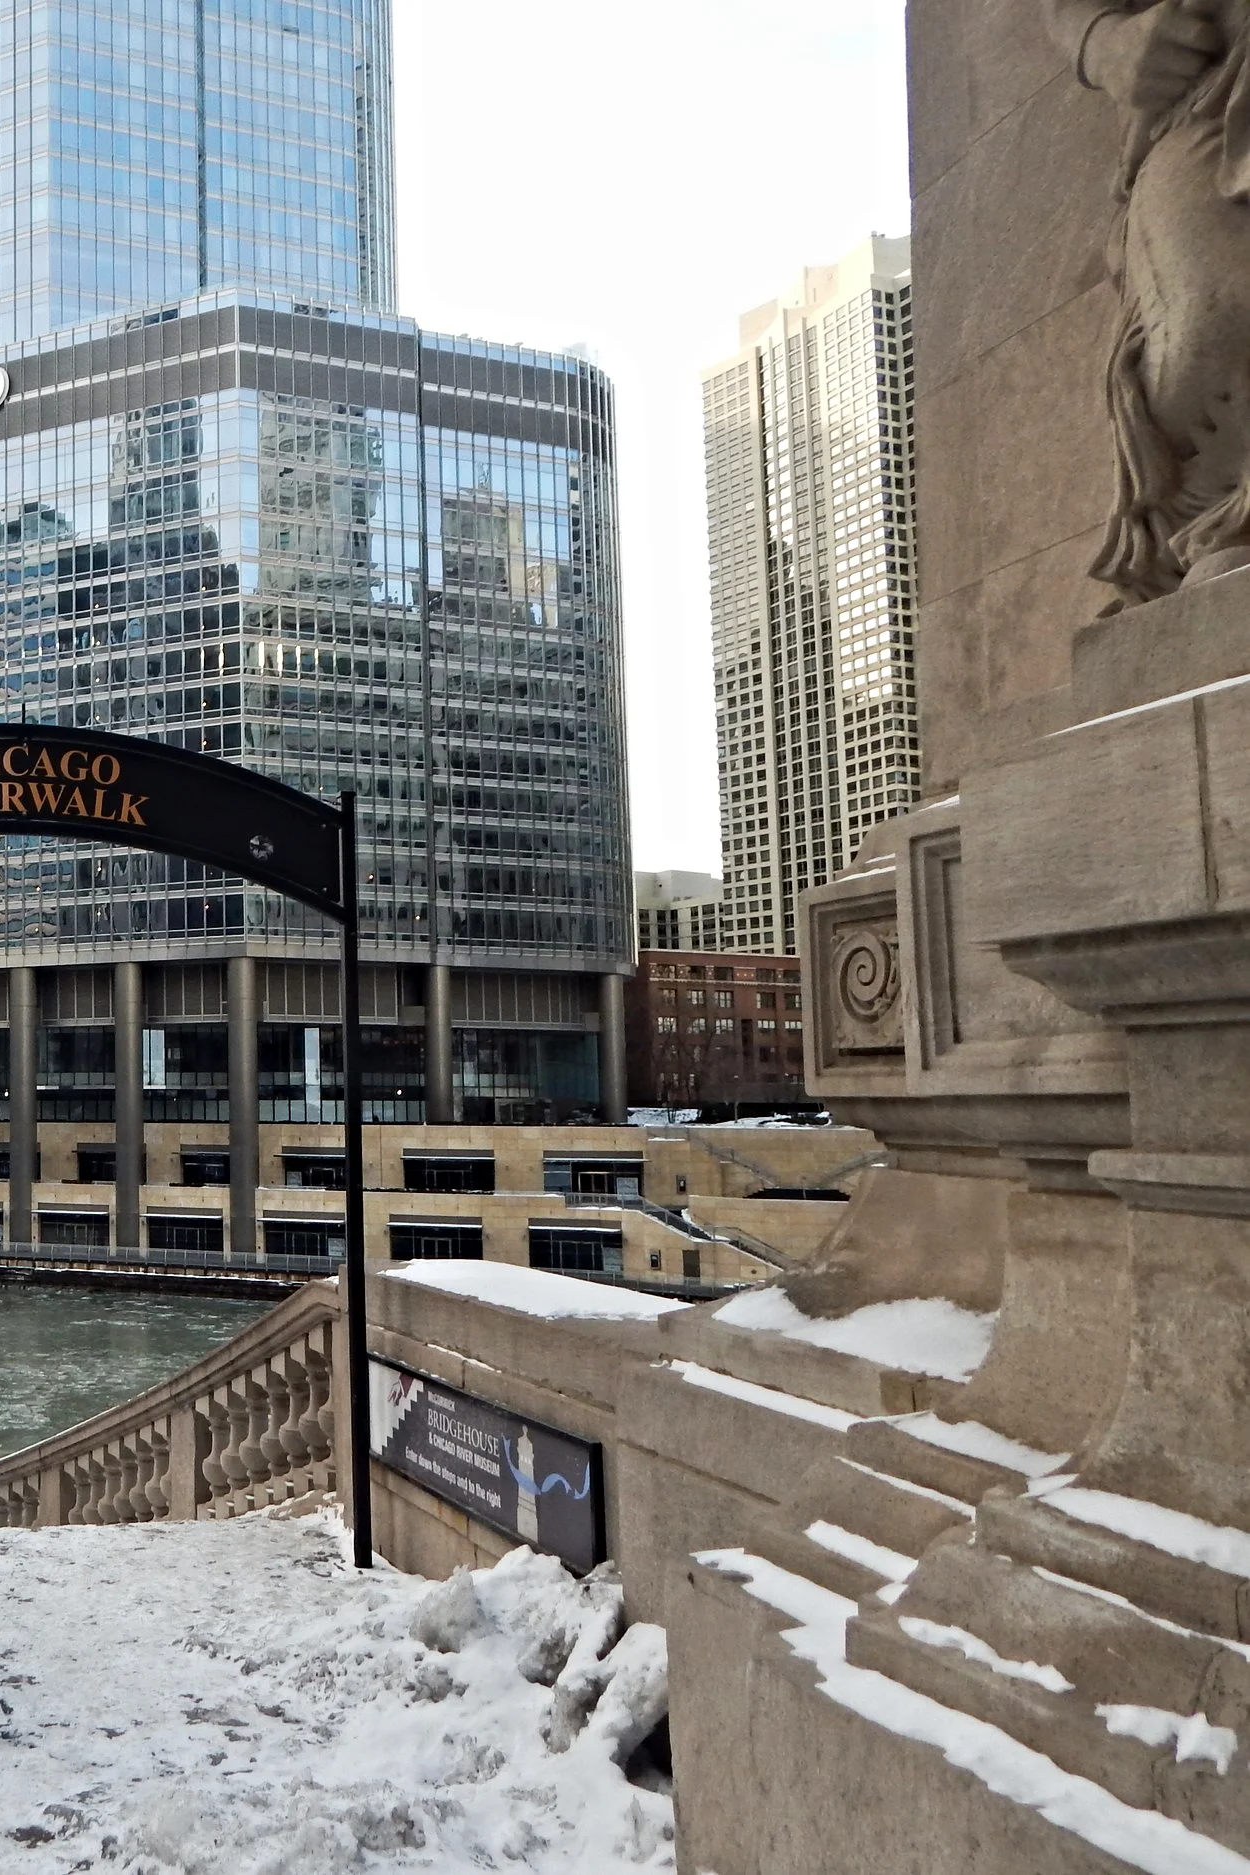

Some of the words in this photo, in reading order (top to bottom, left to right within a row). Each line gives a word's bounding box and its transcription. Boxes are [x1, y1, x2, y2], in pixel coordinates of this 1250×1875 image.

[427, 1408, 500, 1458] BRIDGEHOUSE
[433, 1433, 456, 1456] CHICAGO
[456, 1444, 474, 1465] RIVER
[473, 1452, 501, 1478] MUSEUM
[405, 1445, 418, 1463] Enter
[418, 1452, 433, 1471] down
[432, 1460, 441, 1476] the
[441, 1466, 456, 1485] steps
[456, 1475, 468, 1490] and
[468, 1479, 475, 1494] to
[475, 1483, 486, 1500] the
[486, 1488, 502, 1508] right
